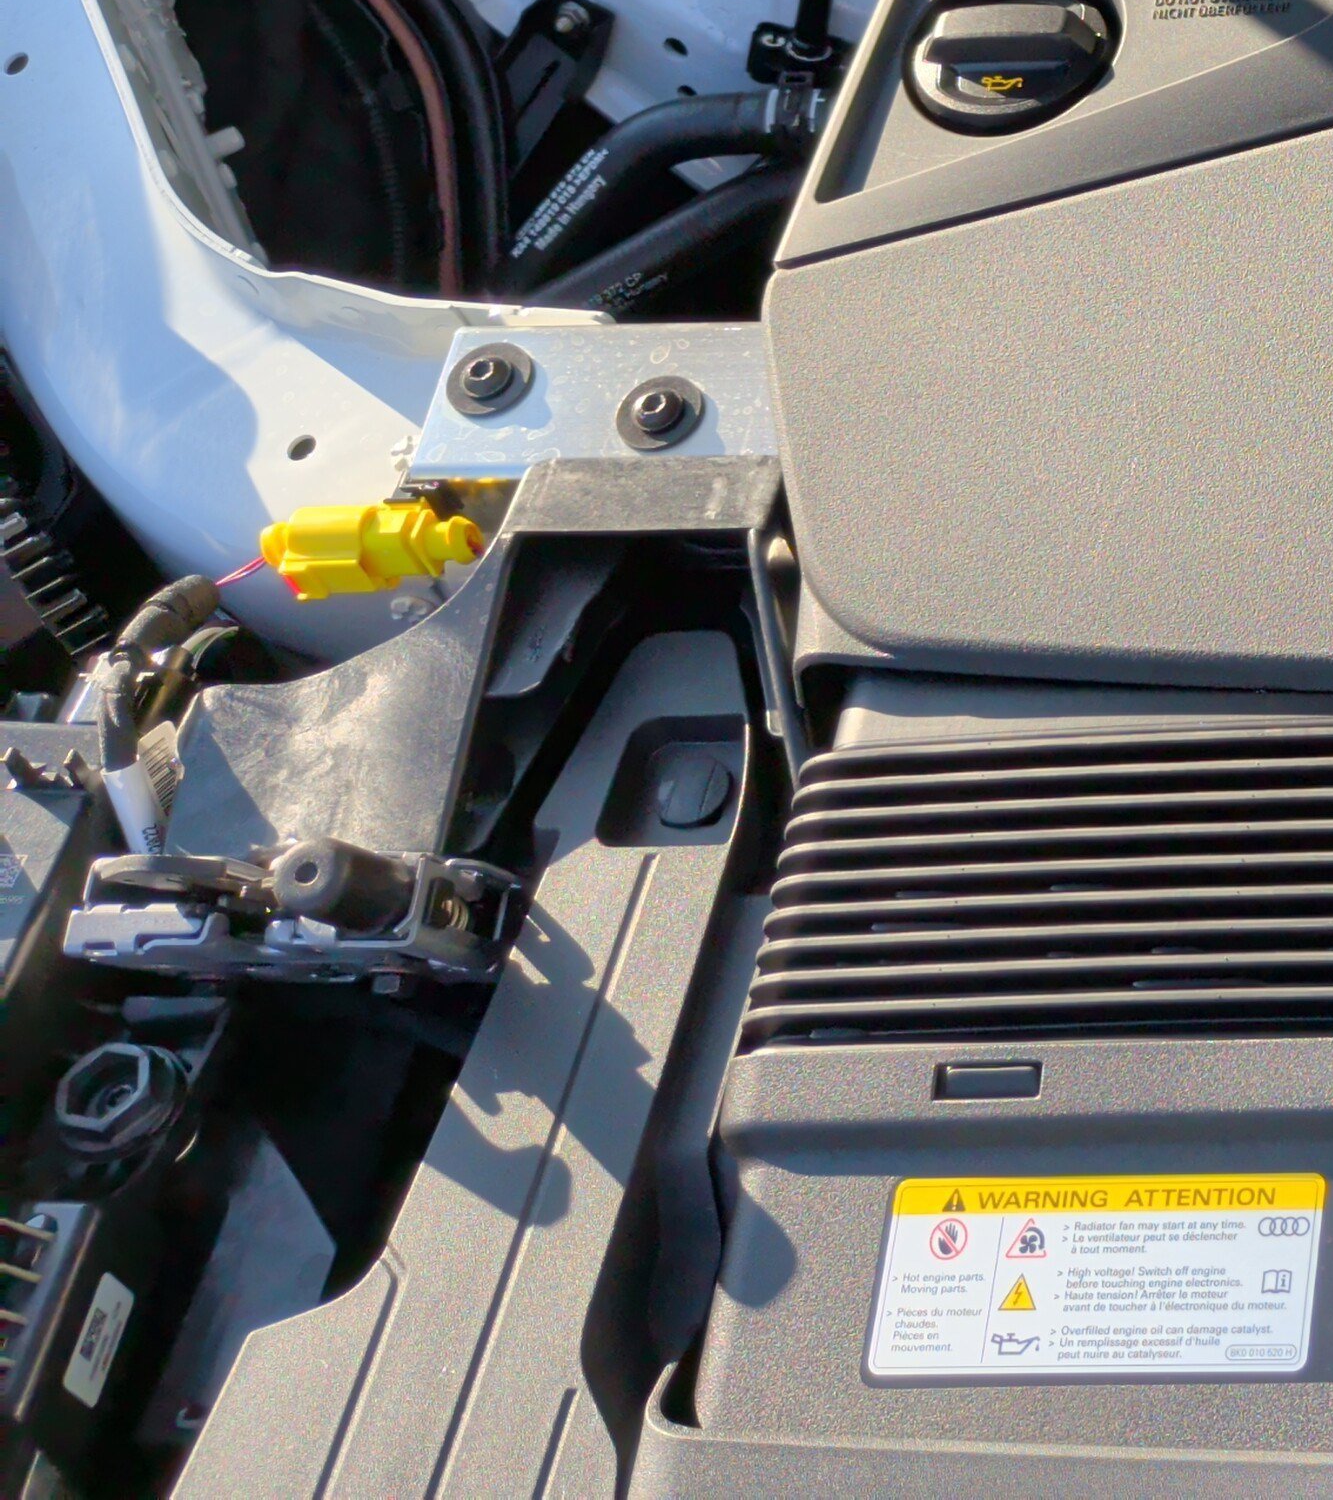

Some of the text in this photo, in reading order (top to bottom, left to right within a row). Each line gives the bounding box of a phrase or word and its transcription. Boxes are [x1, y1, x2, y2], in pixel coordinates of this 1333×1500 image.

[1153, 7, 1196, 20] NICHT
[535, 222, 561, 251] Made
[978, 1187, 1276, 1210] WARNING ATTENTION
[1074, 1220, 1246, 1232] Radiator fan may start at any time.
[1073, 1234, 1084, 1243] Le
[1087, 1233, 1140, 1242] ventilateur
[1143, 1233, 1166, 1244] peut
[1183, 1232, 1237, 1241] déclencher
[1071, 1244, 1147, 1254] à tout moment.
[1068, 1266, 1226, 1279] High voltage! Switch off engine
[903, 1273, 985, 1284] Hot engine parts.
[1066, 1277, 1243, 1290] before touching engine electronics.
[901, 1285, 967, 1295] Moving parts.
[1064, 1289, 1228, 1300] Haute tension! Arrêter le moteur
[931, 1308, 943, 1316] du
[946, 1308, 982, 1316] moteur
[1063, 1302, 1091, 1312] avant
[1094, 1302, 1106, 1312] de
[1109, 1301, 1146, 1311] toucher
[1150, 1301, 1156, 1311] à
[1231, 1301, 1244, 1310] du
[1247, 1301, 1287, 1310] moteur.
[895, 1319, 938, 1329] chaudes.
[893, 1331, 924, 1340] Pièces
[1061, 1325, 1273, 1336] Overfilled engine oil can damage catalyst.
[891, 1343, 953, 1352] mouvement.
[1060, 1337, 1220, 1349] Un remplissage excessif d'huile
[1057, 1349, 1182, 1362] peut nuire au catalyseur.
